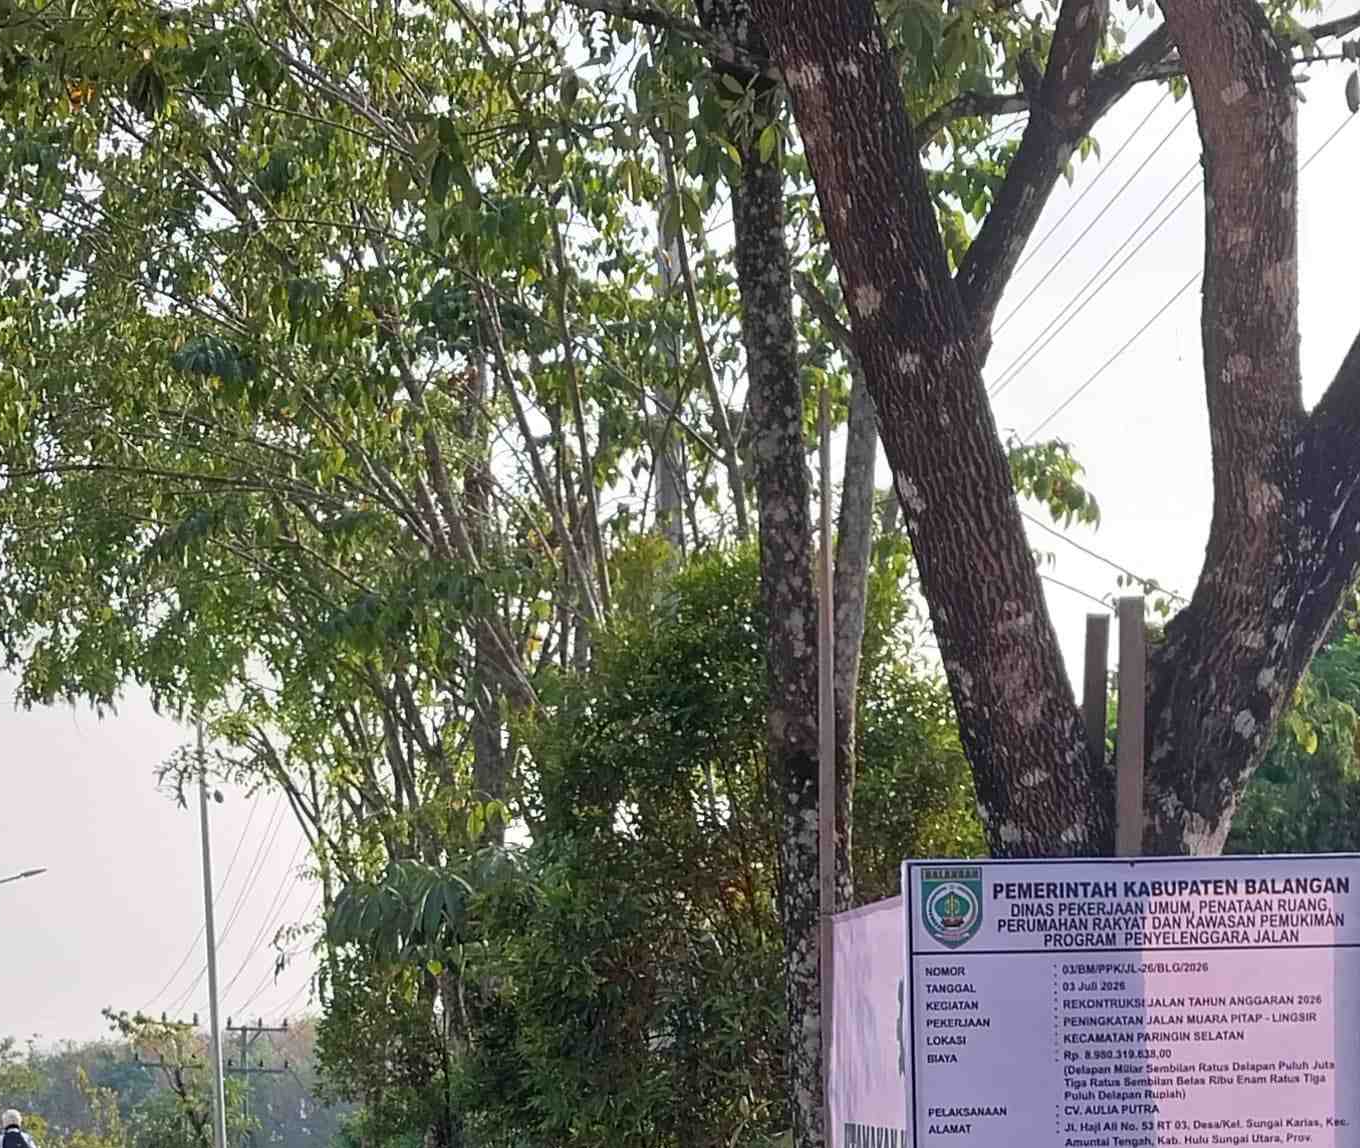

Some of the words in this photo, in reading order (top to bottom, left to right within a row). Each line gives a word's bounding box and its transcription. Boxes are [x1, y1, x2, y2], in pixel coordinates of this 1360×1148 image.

[993, 881, 1117, 900] PEMERINTAH
[1124, 879, 1238, 898] KABUPATEN
[1244, 877, 1350, 895] BALANGAN
[1011, 903, 1054, 917] DINAS
[1058, 902, 1144, 917] PEKERJAAN
[1148, 901, 1195, 916] UMUM,
[1199, 900, 1273, 914] PENATAAN
[1278, 899, 1332, 912] RUANG,
[997, 918, 1089, 933] PERUMAHAN
[1092, 917, 1148, 931] RAKYAT
[1152, 915, 1181, 930] DAN
[1186, 914, 1257, 929] KAWASAN
[1260, 913, 1345, 928] PEMUKIMAN
[1044, 933, 1117, 947] PROGRAM
[1124, 931, 1250, 945] PENYELENGGARA
[1253, 930, 1299, 944] JALAN
[925, 966, 966, 977] NOMOR
[926, 984, 976, 993] TANGGAL
[1062, 982, 1076, 992] 03
[1078, 981, 1098, 992] Juli
[1101, 981, 1126, 991] 2026
[926, 1001, 979, 1011] KEGIATAN
[1063, 998, 1145, 1009] REKONTRUKSI
[1147, 998, 1185, 1008] JALAN
[1189, 997, 1226, 1007] TAHUN
[1229, 996, 1295, 1007] ANGGARAN
[1297, 995, 1322, 1005] 2026
[926, 1018, 991, 1028] PEKERJAAN
[1063, 1016, 1144, 1027] PENINGKATAN
[1147, 1015, 1184, 1025] JALAN
[1187, 1014, 1228, 1024] MUARA
[1230, 1013, 1263, 1023] PITAP
[1272, 1012, 1317, 1023] LINGSIR
[926, 1036, 967, 1046] LOKASI
[1063, 1033, 1134, 1044] KECAMATAN
[1137, 1032, 1191, 1043] PARINGIN
[1193, 1030, 1245, 1041] SELATAN
[927, 1054, 958, 1063] BIAYA
[1064, 1064, 1111, 1076] (Delapan
[1146, 1063, 1196, 1073] Sembilan
[1198, 1063, 1229, 1072] Ratus
[1232, 1062, 1276, 1073] Delapan
[1279, 1061, 1309, 1071] Puluh
[1312, 1060, 1335, 1071] Juta
[1064, 1078, 1087, 1089] Tiga
[1090, 1078, 1120, 1087] Ratus
[1124, 1076, 1173, 1087] Sembilan
[1176, 1075, 1206, 1086] Belas
[1209, 1074, 1234, 1085] Ribu
[1236, 1074, 1268, 1085] Enam
[1270, 1074, 1301, 1084] Ratus
[1303, 1073, 1327, 1085] Tiga
[1064, 1091, 1095, 1100] Puluh
[1098, 1090, 1142, 1101] Delapan
[1144, 1088, 1186, 1100] Rupiah)
[928, 1107, 1008, 1117] PELAKSANAAN
[1064, 1106, 1082, 1115] CV.
[1085, 1105, 1120, 1115] AULIA
[1121, 1104, 1160, 1114] PUTRA
[928, 1124, 972, 1134] ALAMAT
[1080, 1122, 1101, 1133] Haji
[1103, 1121, 1118, 1131] Ali
[1120, 1122, 1139, 1131] No.
[1142, 1121, 1154, 1131] 53
[1157, 1121, 1171, 1131] RT
[1245, 1118, 1283, 1131] Sungai
[1285, 1118, 1324, 1129] Karias,
[1326, 1117, 1350, 1127] Kec.
[1065, 1137, 1109, 1147] Amuntai
[1112, 1136, 1154, 1148] Tengah,
[1157, 1135, 1182, 1145] Kab.
[1184, 1134, 1209, 1144] Hulu
[1211, 1134, 1249, 1146] Sungai
[1251, 1133, 1284, 1144] Utara,
